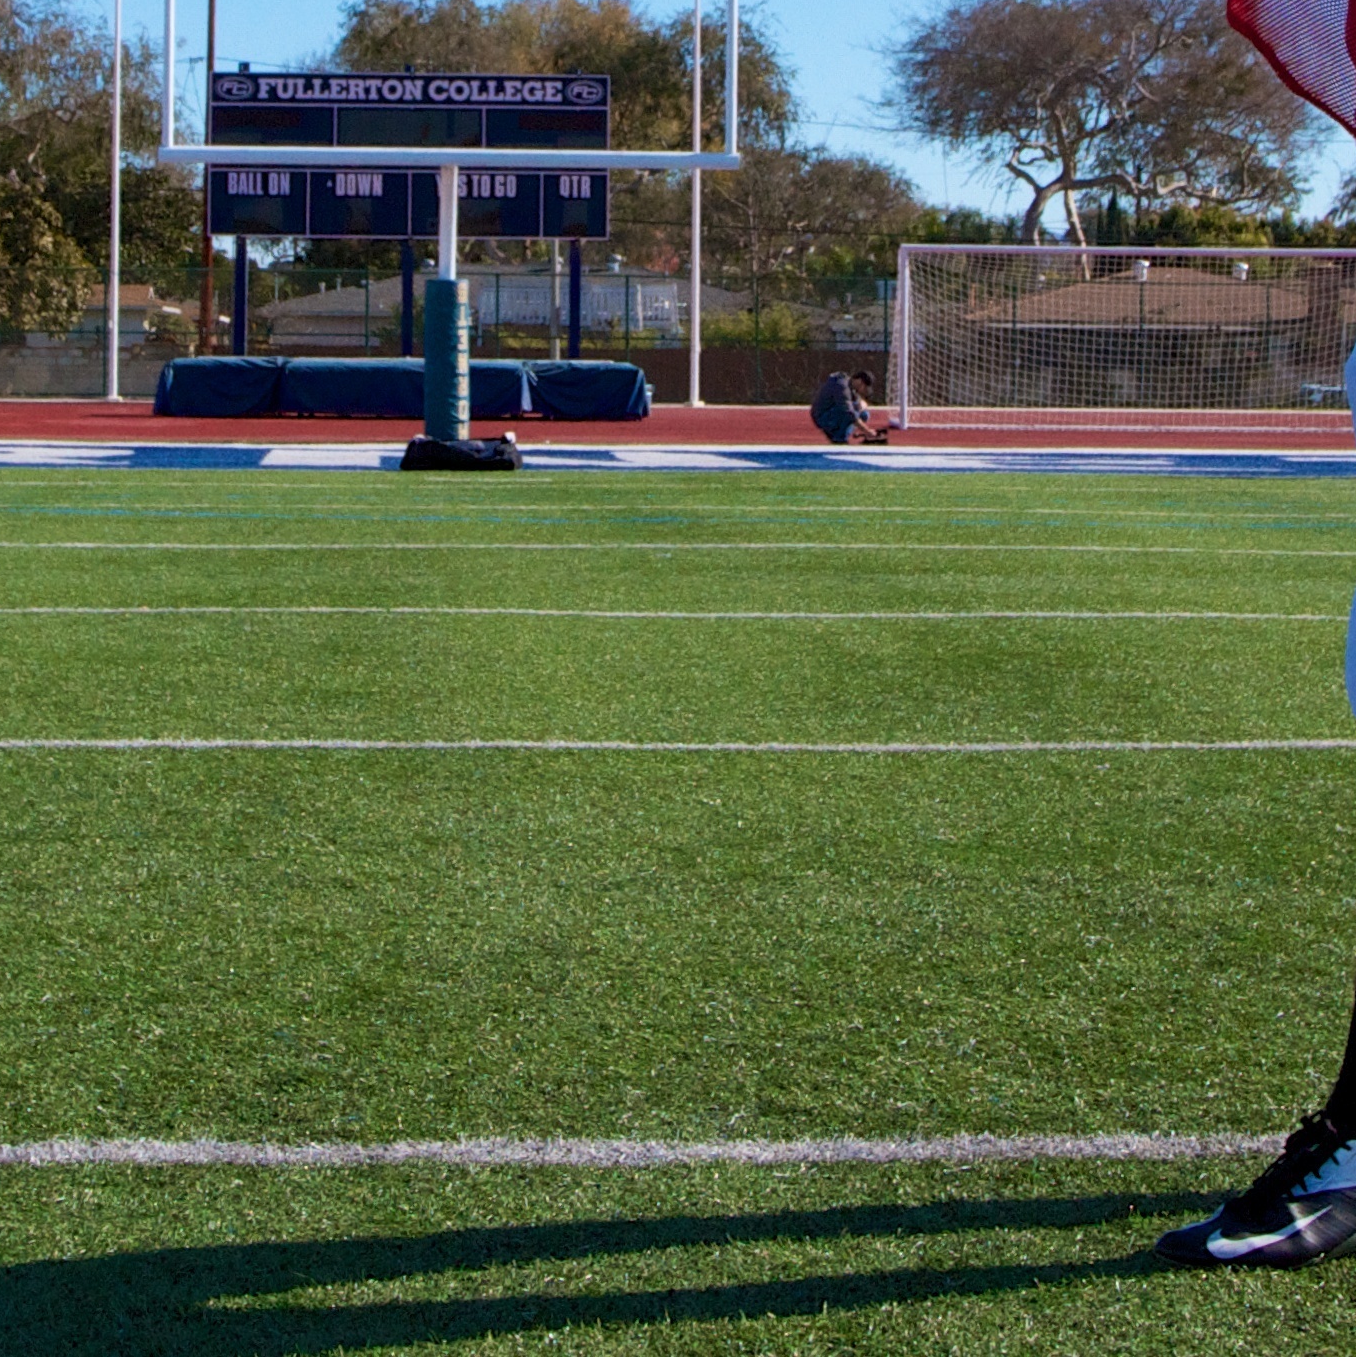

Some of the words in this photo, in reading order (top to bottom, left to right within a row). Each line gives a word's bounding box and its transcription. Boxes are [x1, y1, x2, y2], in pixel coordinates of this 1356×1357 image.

[257, 78, 425, 101] FULLERTON
[427, 80, 563, 103] COLLEGE
[227, 172, 264, 196] BALL
[268, 172, 291, 196] ON
[335, 173, 383, 197] DOWN
[471, 175, 491, 198] TO
[494, 175, 517, 198] GO
[559, 175, 592, 199] QTR
